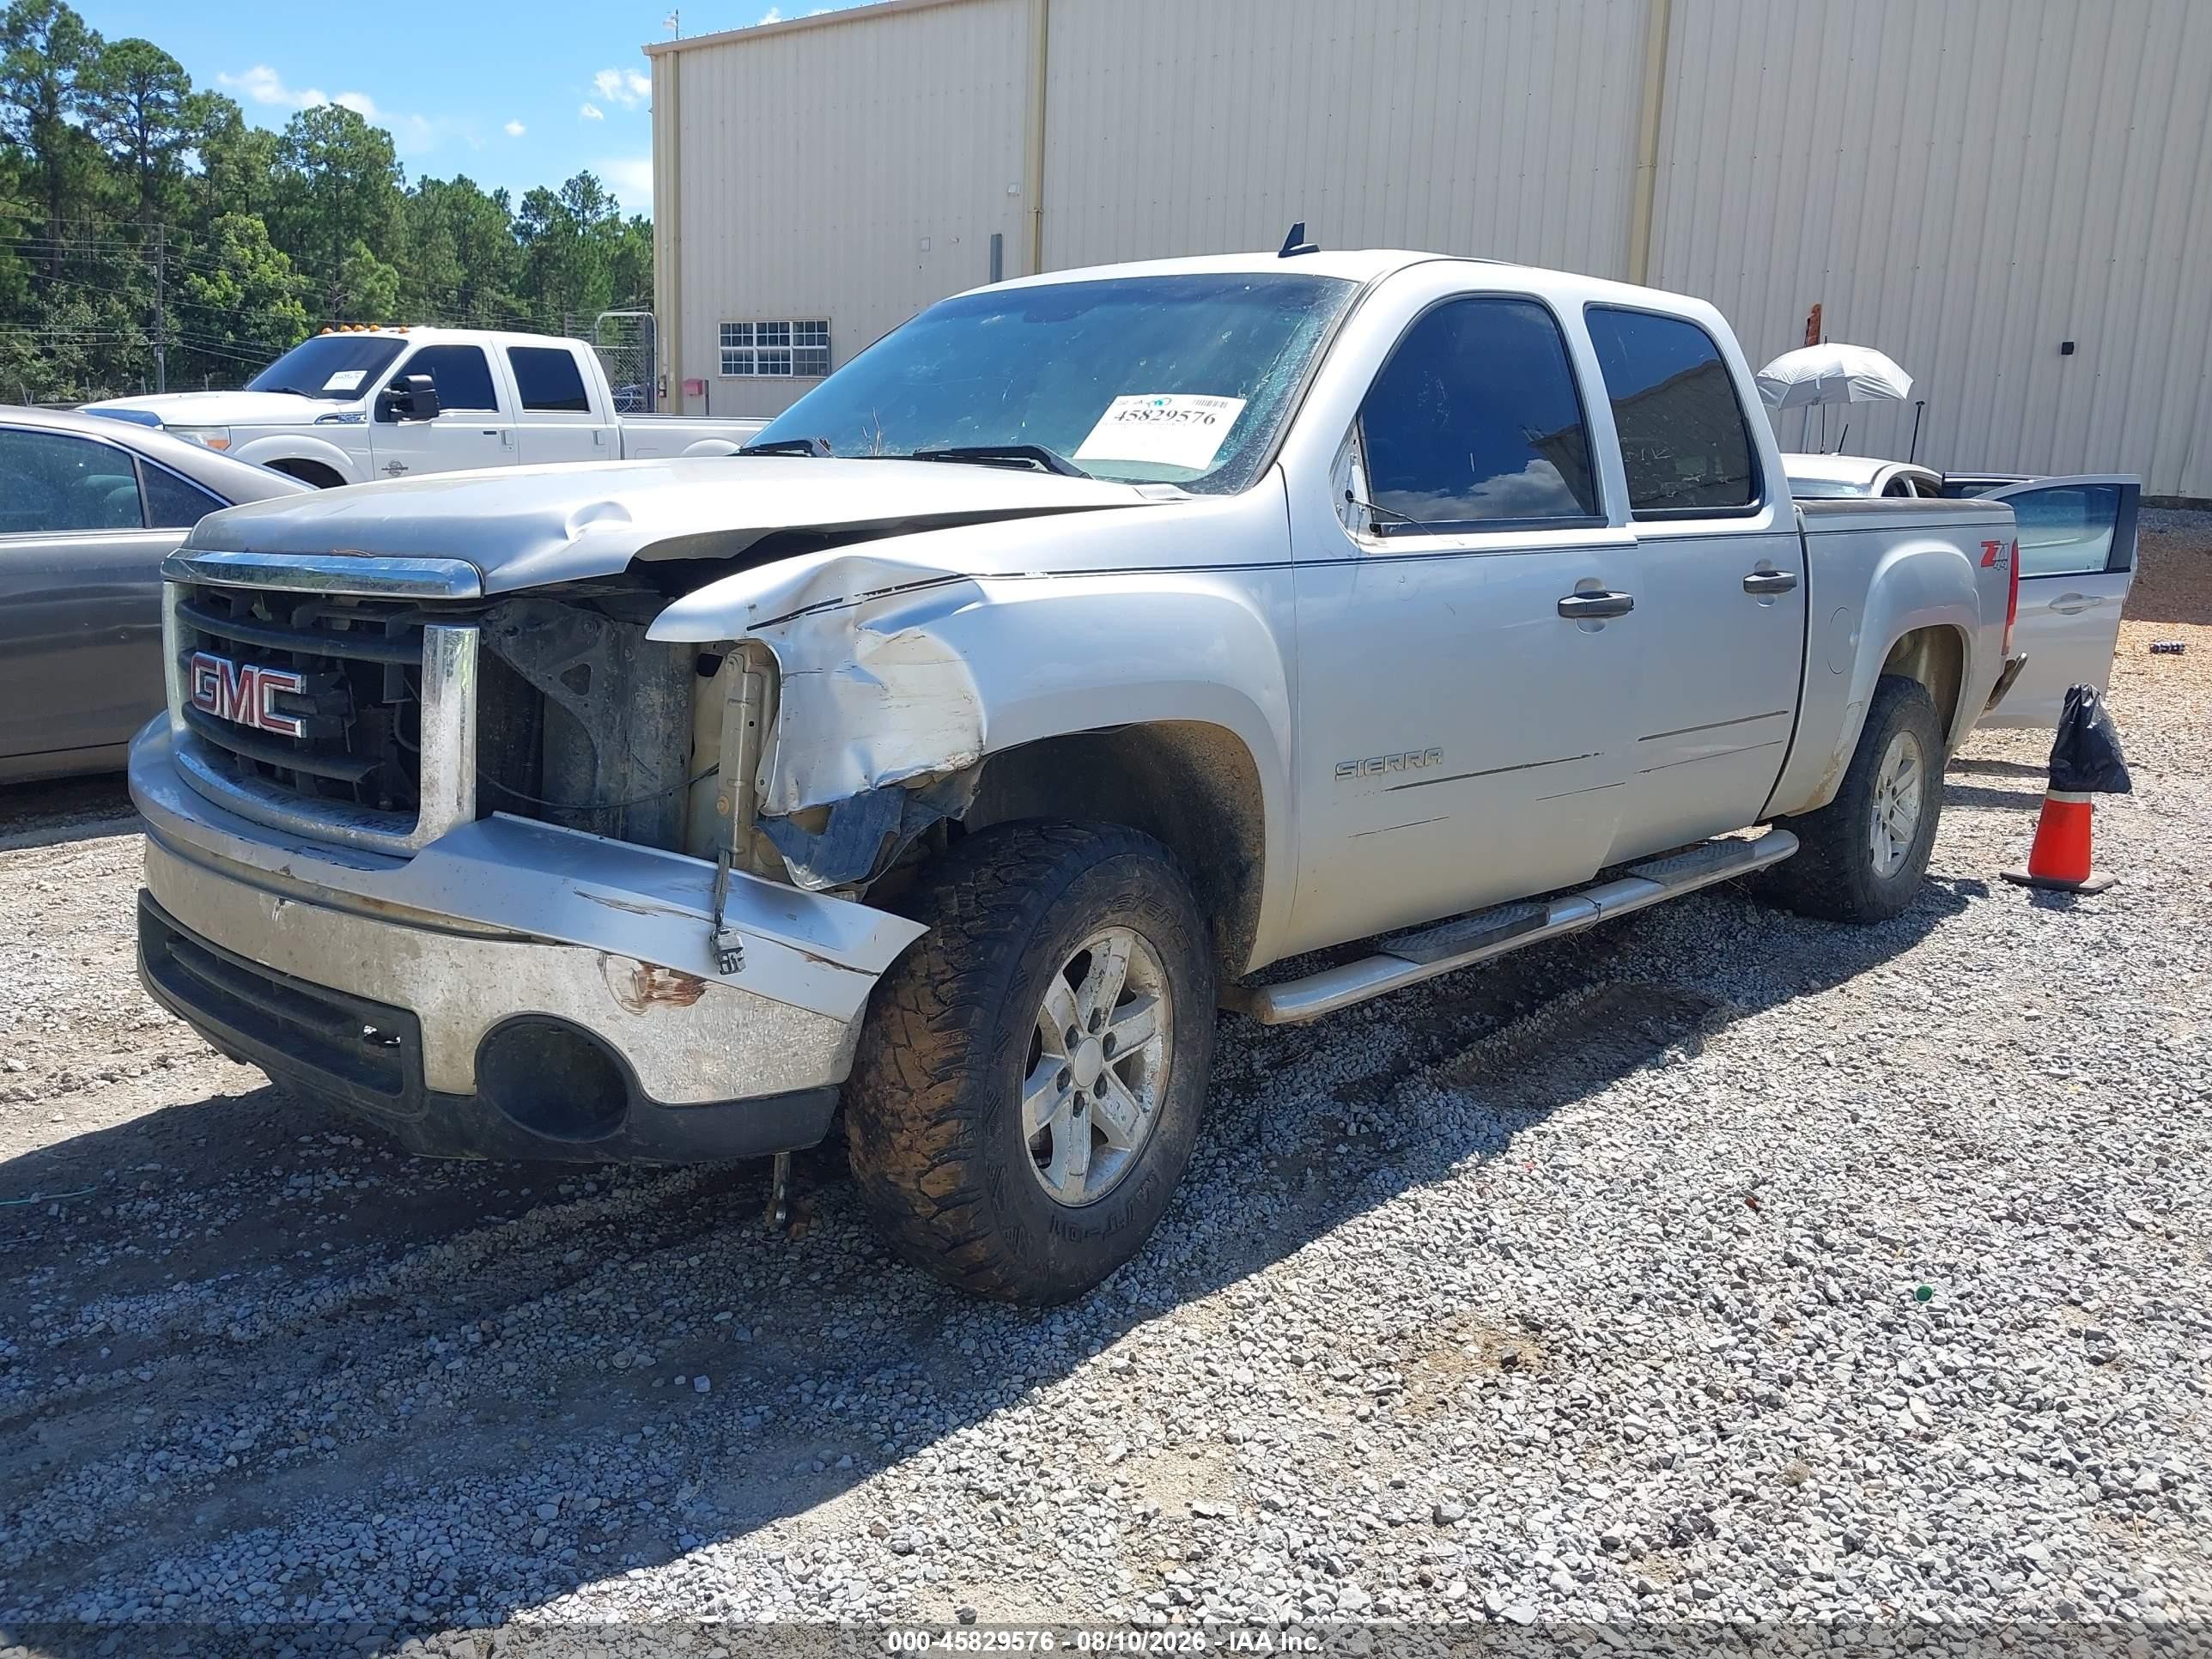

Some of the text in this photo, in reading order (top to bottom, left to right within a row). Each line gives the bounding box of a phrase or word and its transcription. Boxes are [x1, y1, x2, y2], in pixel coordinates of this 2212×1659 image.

[1114, 409, 1217, 426] 45829576
[191, 651, 307, 738] GMC
[1334, 746, 1444, 782] SIERRA
